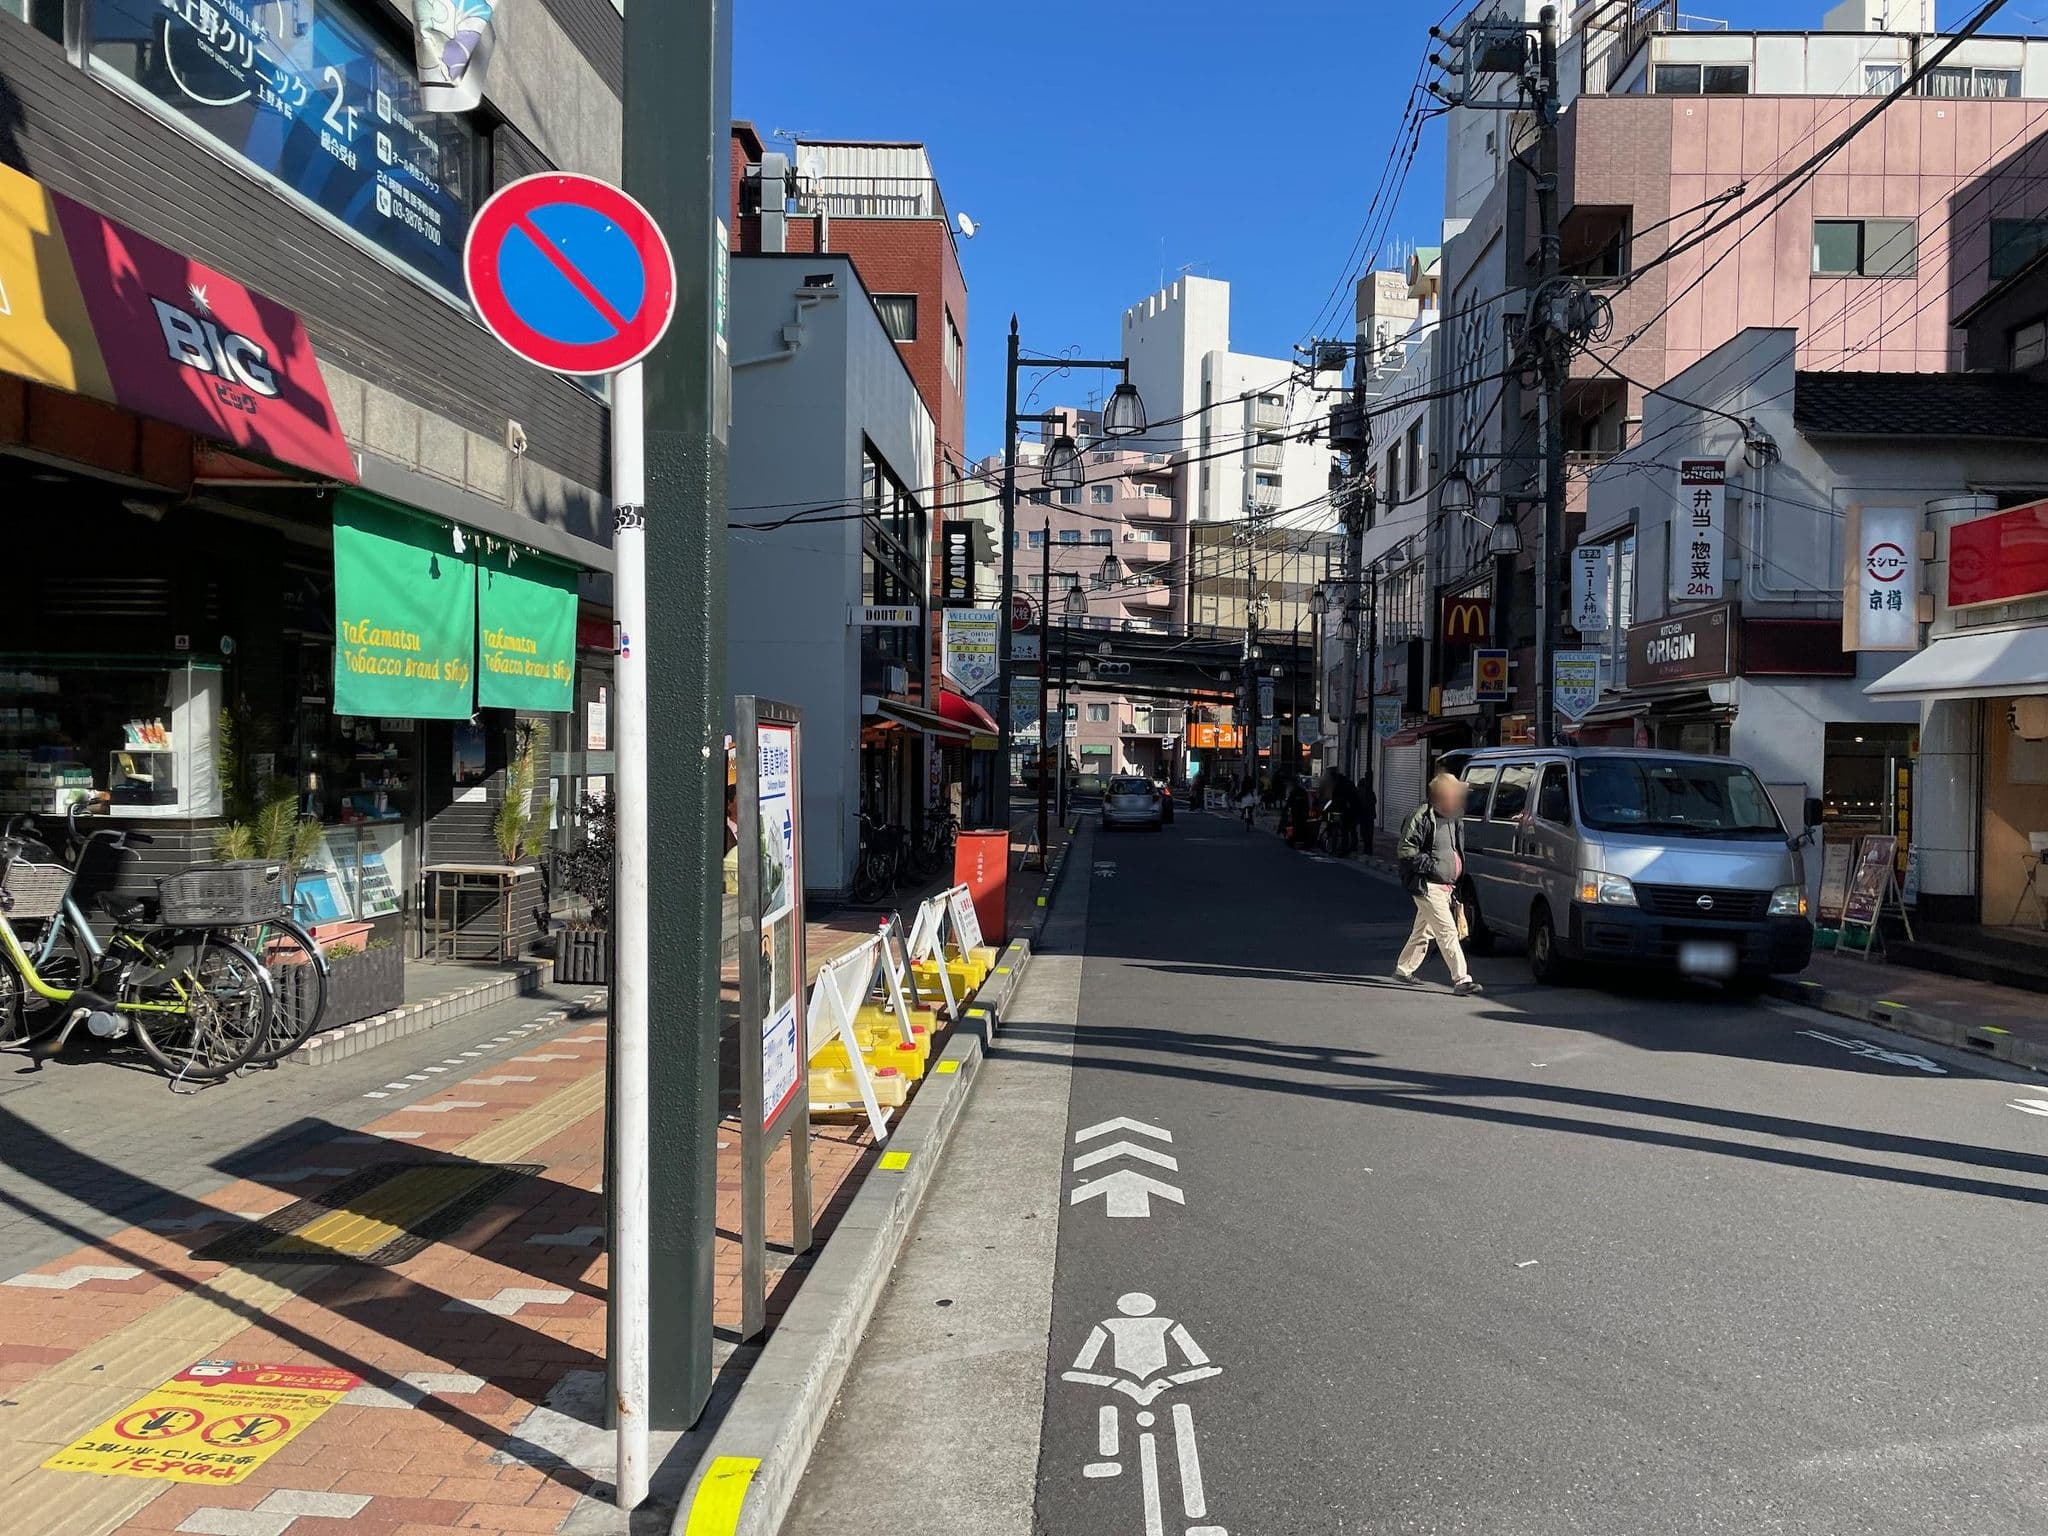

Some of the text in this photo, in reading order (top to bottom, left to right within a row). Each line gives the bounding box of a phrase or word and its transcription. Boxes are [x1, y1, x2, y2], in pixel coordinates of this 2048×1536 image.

[322, 65, 359, 142] 2F
[150, 296, 281, 397] BIG
[215, 382, 257, 415] ビッグ
[1682, 470, 1724, 480] ORIGIN
[1690, 488, 1712, 580] 弁当・惣菜
[1866, 557, 1908, 568] スシロー
[1687, 582, 1714, 596] 24h
[1869, 589, 1902, 611] 京樽
[342, 618, 421, 651] Takamatsu
[1660, 623, 1683, 636] KITCHEN
[344, 647, 402, 675] Tobacco
[1647, 633, 1696, 665] ORIGIN
